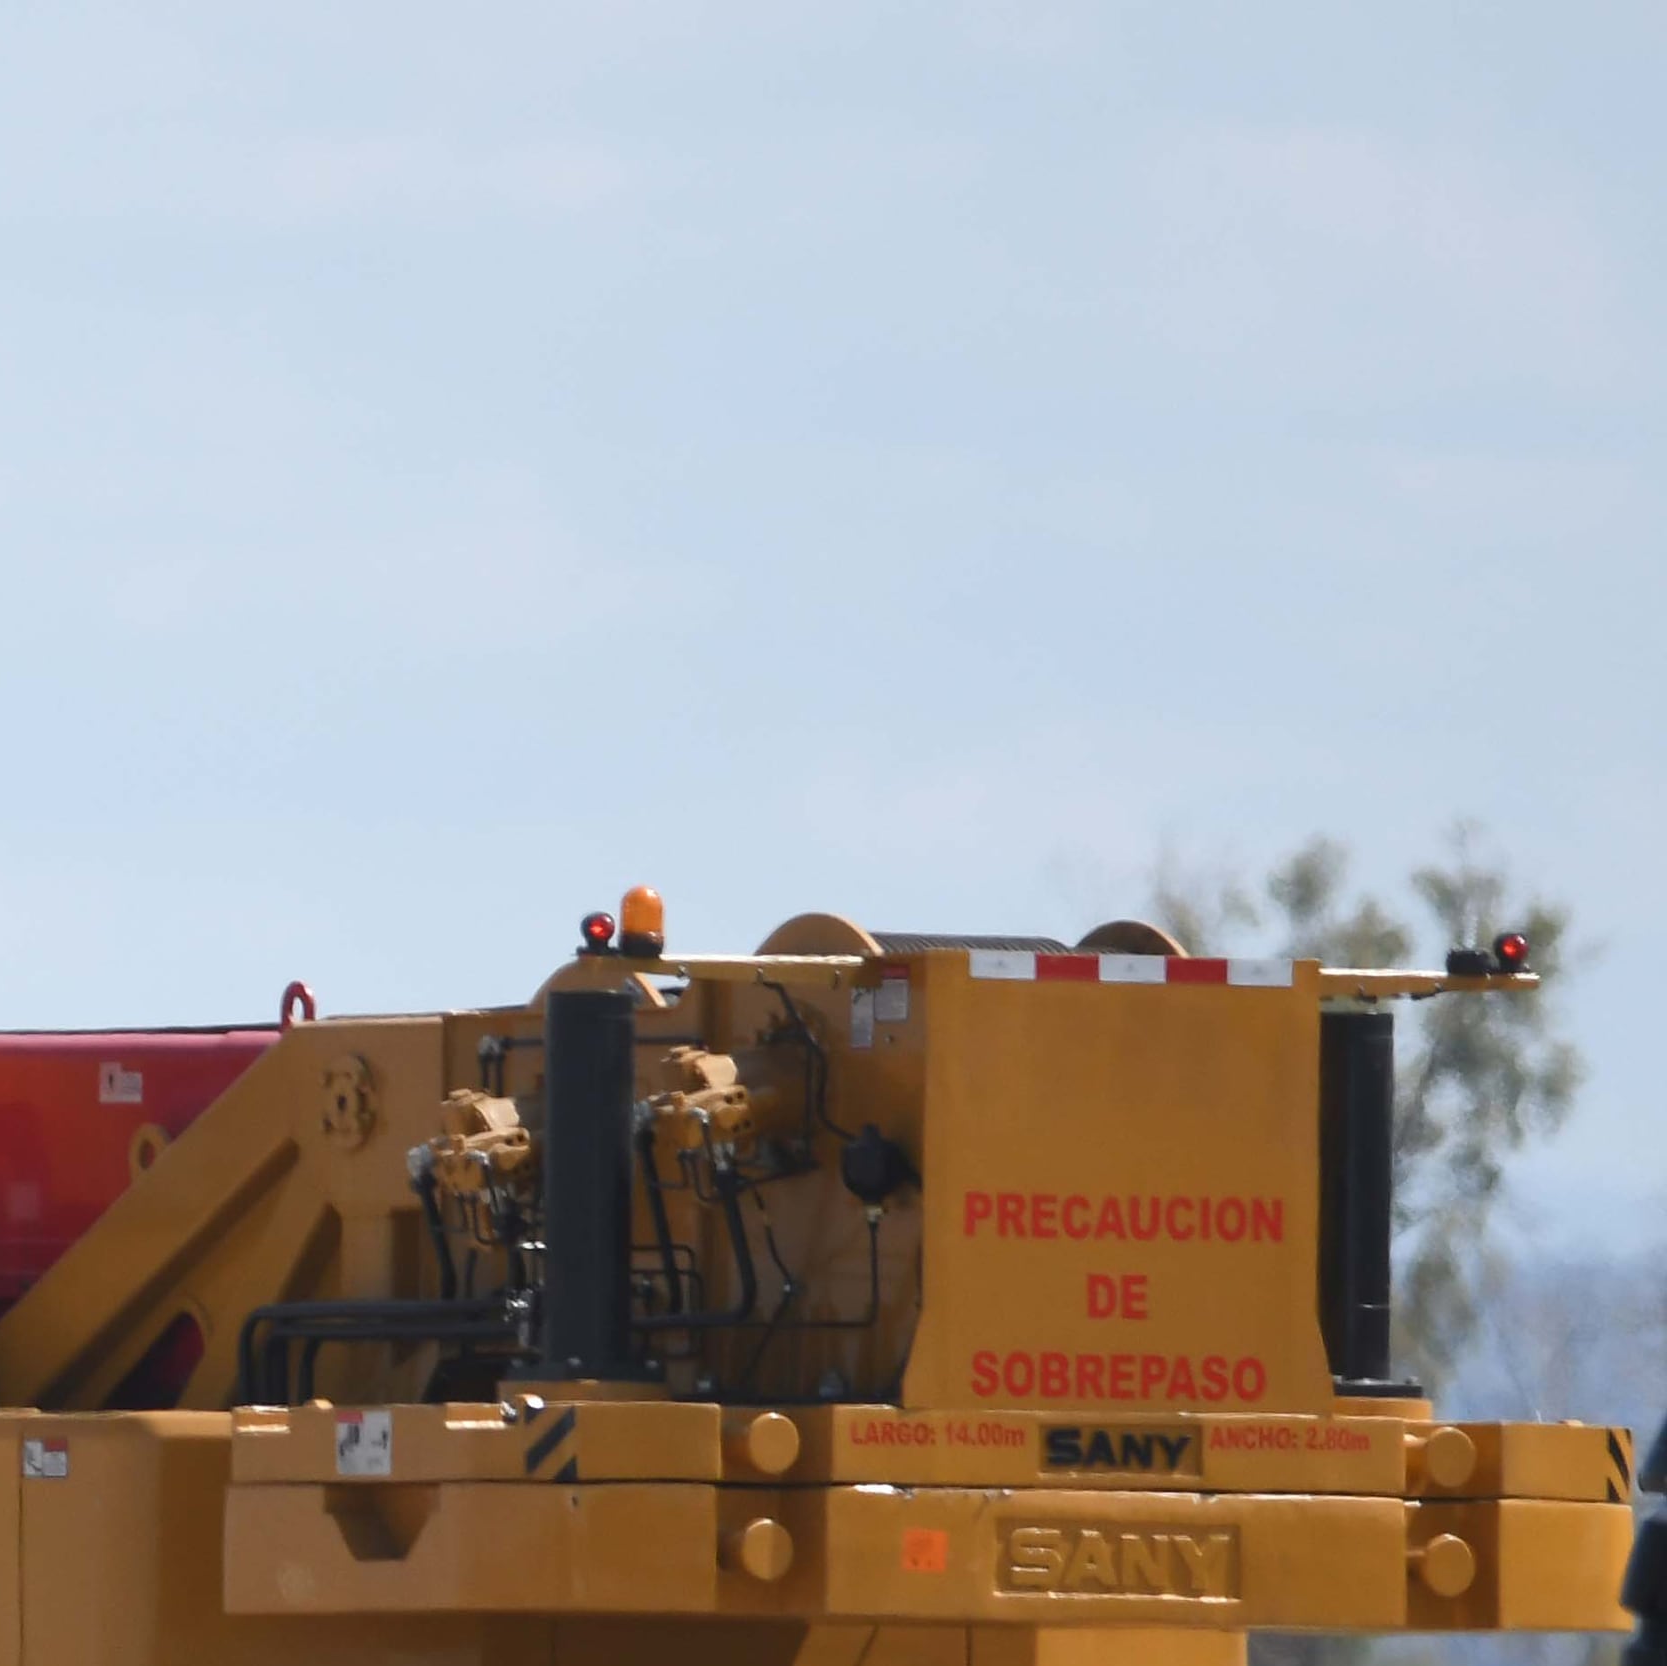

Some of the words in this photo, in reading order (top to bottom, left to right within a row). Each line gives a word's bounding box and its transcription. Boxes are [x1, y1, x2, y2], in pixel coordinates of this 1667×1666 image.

[962, 1190, 1285, 1243] PRECAUCION
[1086, 1273, 1149, 1321] DE
[970, 1349, 1267, 1402] SOBREPASO
[849, 1420, 937, 1446] LARGO:
[944, 1421, 1027, 1447] 14.00m
[1045, 1427, 1193, 1472] SANY
[1208, 1425, 1299, 1450] ANCHO:
[1305, 1426, 1372, 1451] 2.80m
[1010, 1525, 1231, 1596] SANY
